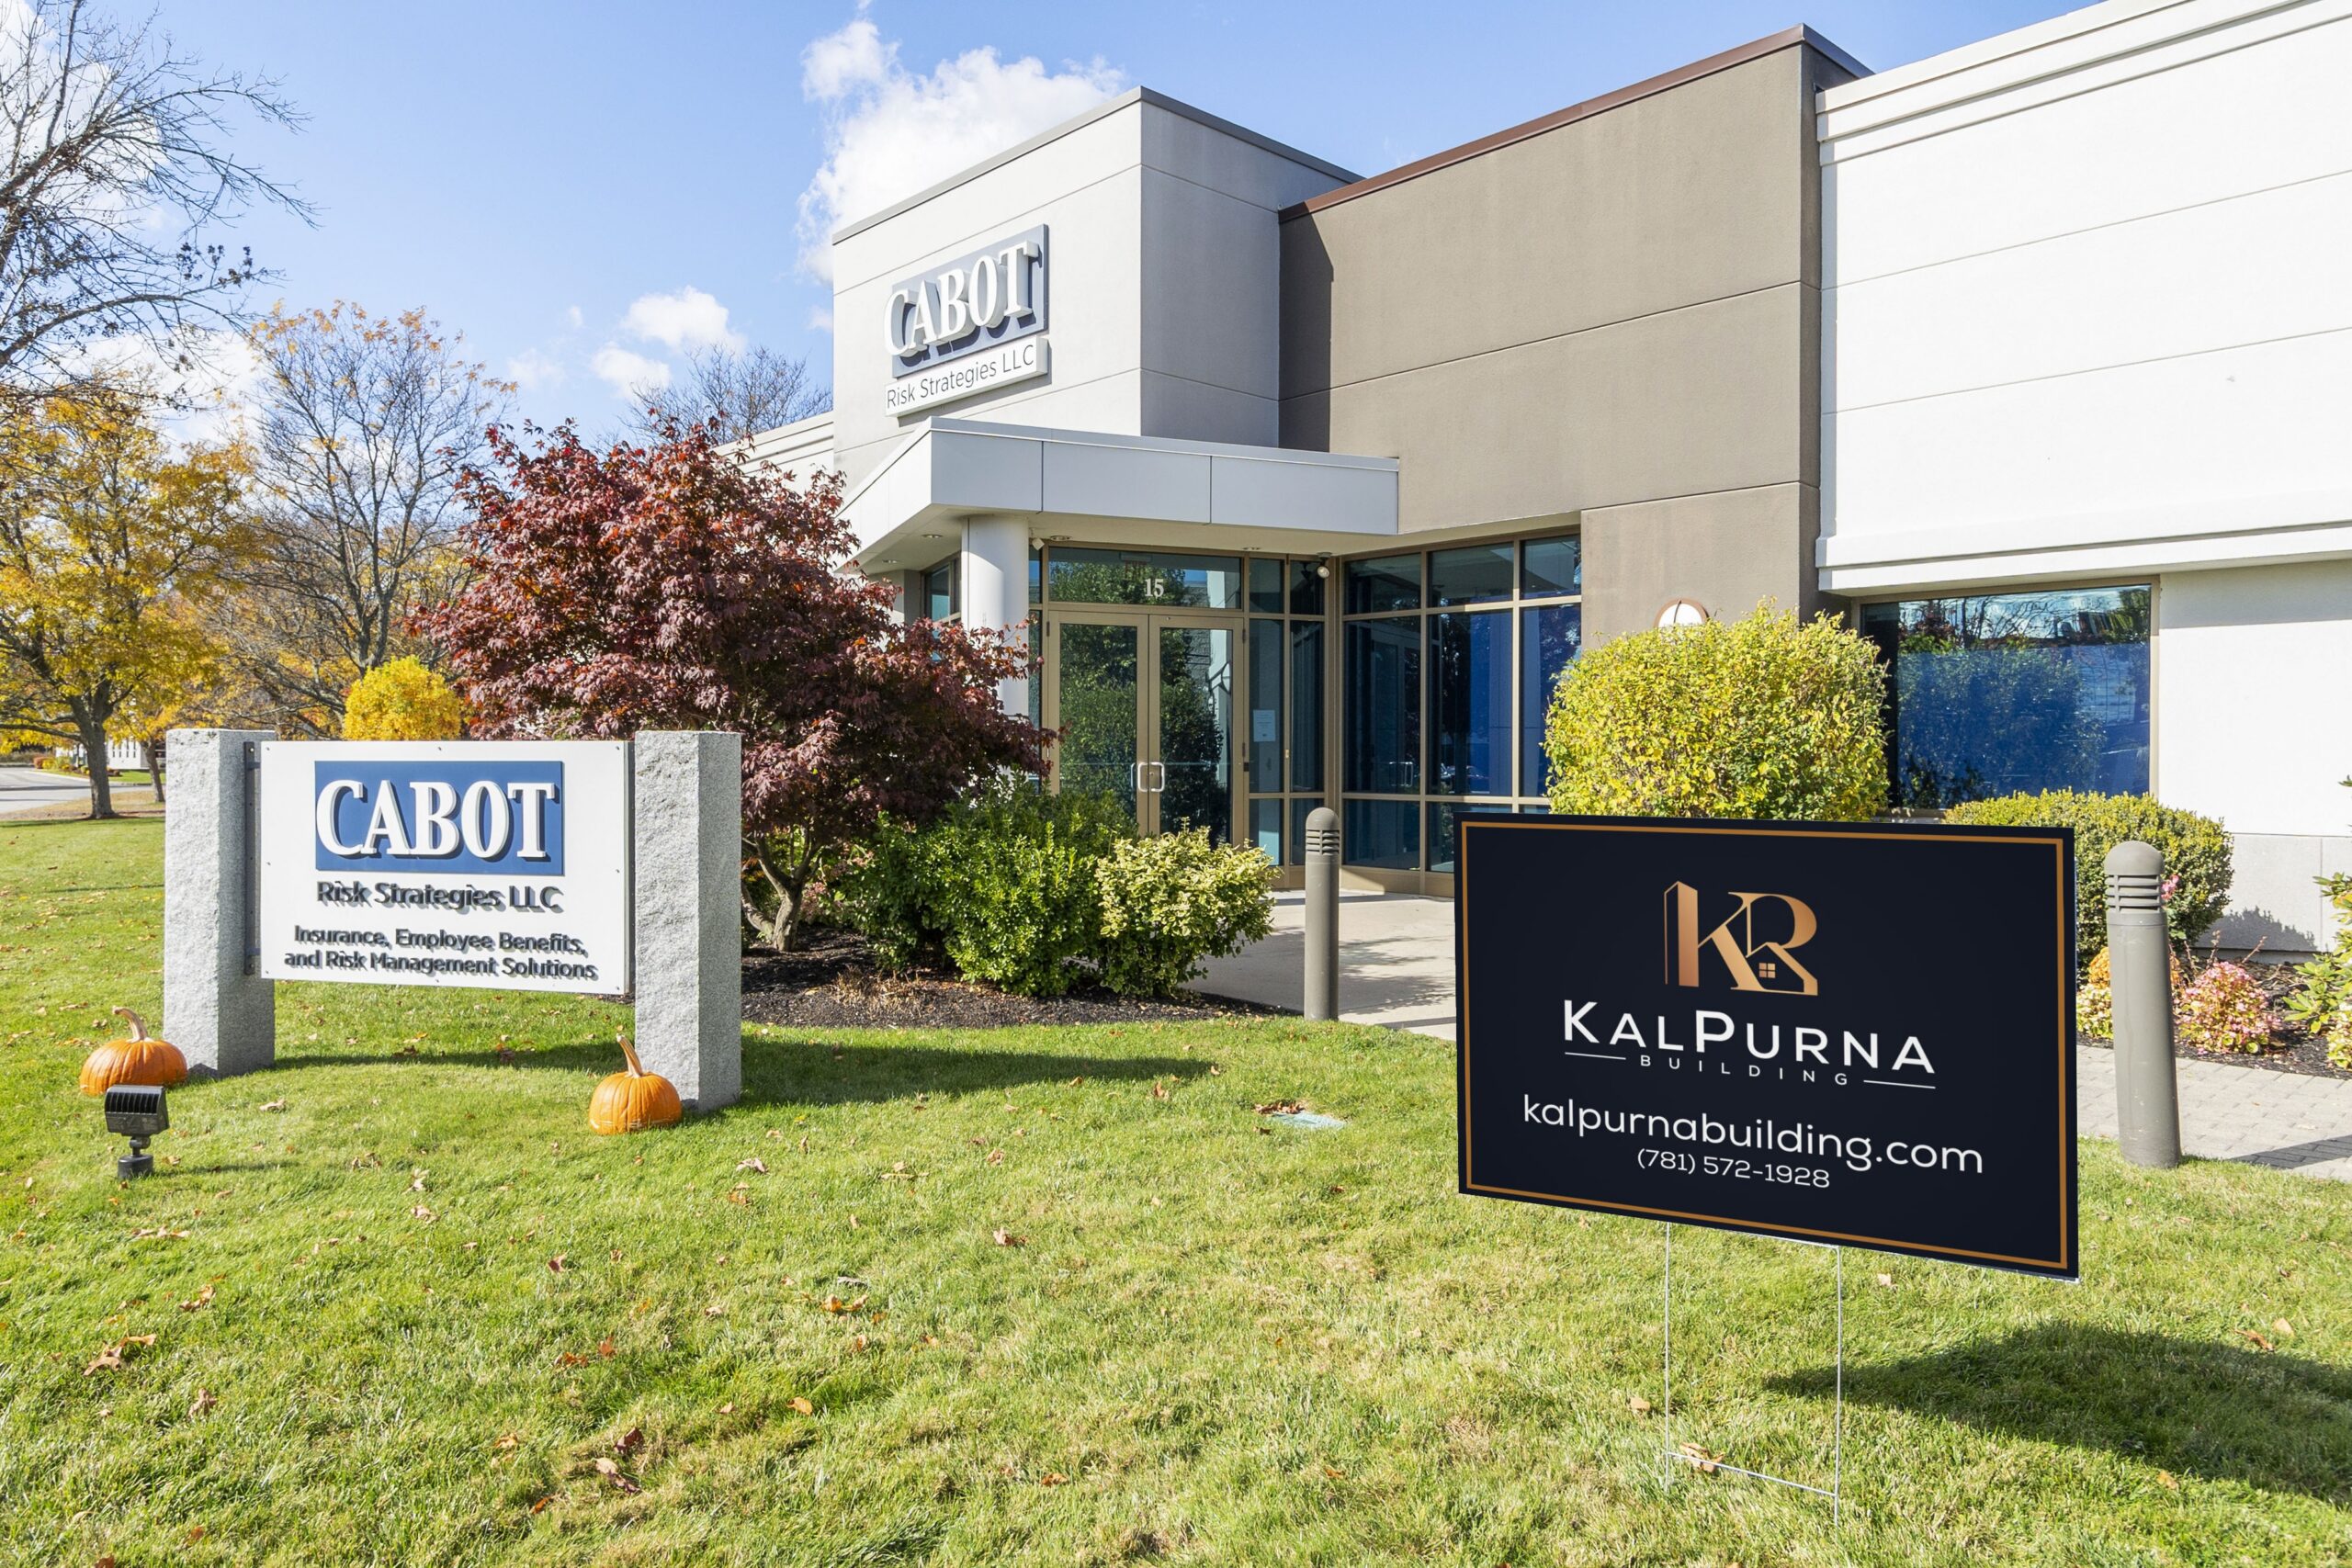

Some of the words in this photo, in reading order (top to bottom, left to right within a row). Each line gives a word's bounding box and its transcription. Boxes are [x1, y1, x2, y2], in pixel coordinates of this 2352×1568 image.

[884, 241, 1039, 357] CABOT
[887, 383, 916, 409] Risk
[920, 360, 997, 399] Strategies
[1002, 344, 1035, 373] LLC
[1145, 578, 1165, 600] 15
[316, 780, 555, 858] CABOT
[317, 881, 372, 907] Risk
[374, 883, 506, 915] Strategies
[509, 886, 564, 913] LLC
[294, 925, 392, 950] Insurance,
[395, 929, 496, 954] Employee
[499, 931, 589, 958] Benefits,
[284, 950, 322, 969] and
[325, 951, 368, 971] Risk
[370, 952, 499, 977] Management
[502, 957, 599, 981] Solutions
[1640, 1055, 1848, 1086] BUILDING
[1523, 1094, 1984, 1174] kalpurnabuilding.com
[1637, 1148, 1696, 1174] (781)
[1703, 1156, 1830, 1189] 572-1928
